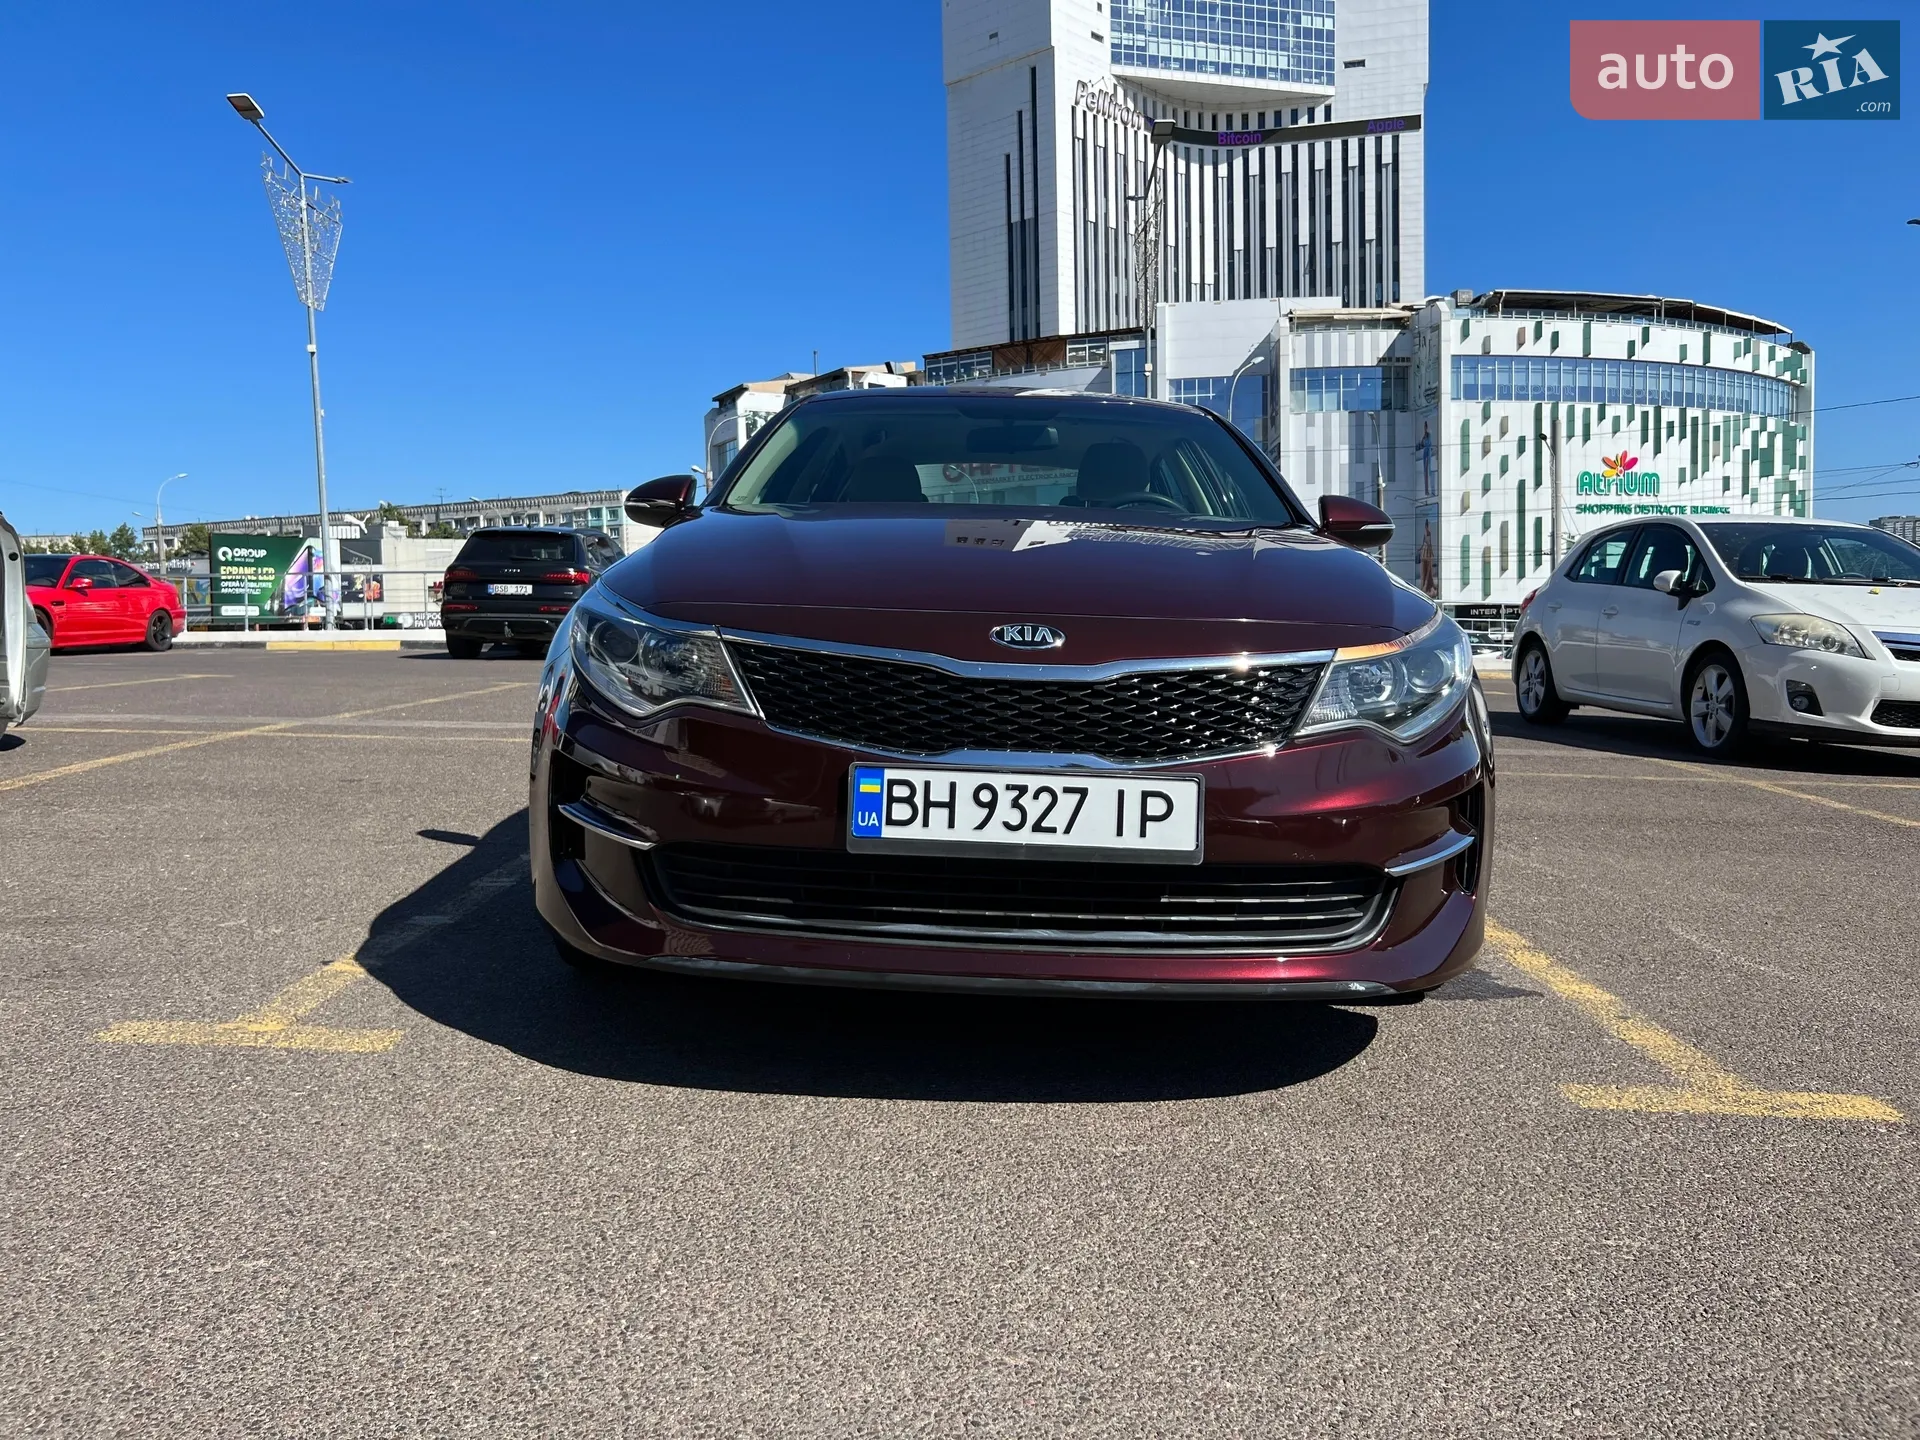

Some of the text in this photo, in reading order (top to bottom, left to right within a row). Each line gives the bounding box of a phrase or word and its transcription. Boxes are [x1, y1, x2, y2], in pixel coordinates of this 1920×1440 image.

[1218, 119, 1405, 145] Bitcoin Apple
[1576, 503, 1633, 515] SHOPPING
[515, 585, 528, 593] 171
[1470, 608, 1497, 616] INTER
[1003, 625, 1054, 642] KIA
[885, 778, 1174, 838] BH 9327 IP
[858, 812, 879, 827] UA
